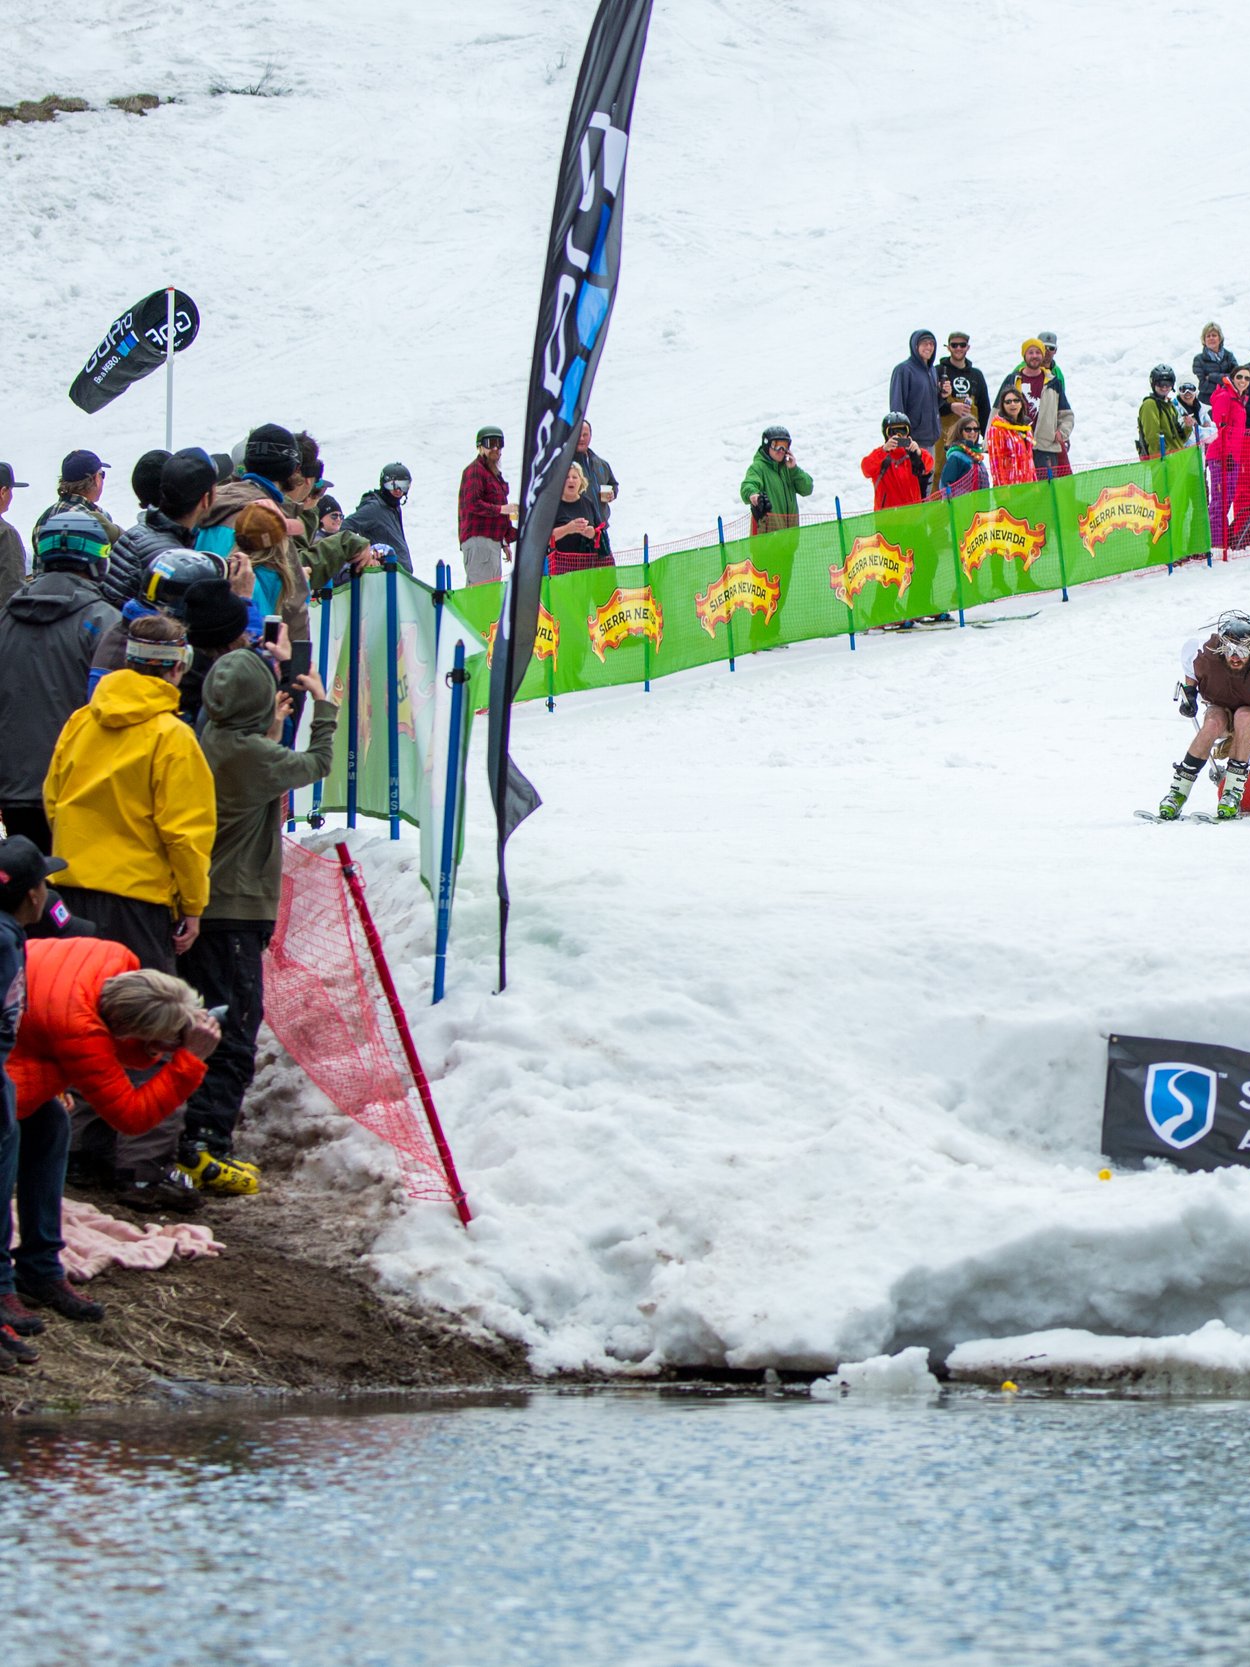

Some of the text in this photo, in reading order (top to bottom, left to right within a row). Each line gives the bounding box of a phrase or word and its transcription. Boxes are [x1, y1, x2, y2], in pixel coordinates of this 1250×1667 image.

[1089, 503, 1155, 533] SIERRA NEVADA
[966, 529, 1026, 559] SIERRA NEVADA
[848, 554, 900, 584] SIERRA NEVADA
[709, 581, 766, 613] SIERRA NEVADA
[599, 609, 632, 637] SIERRA
